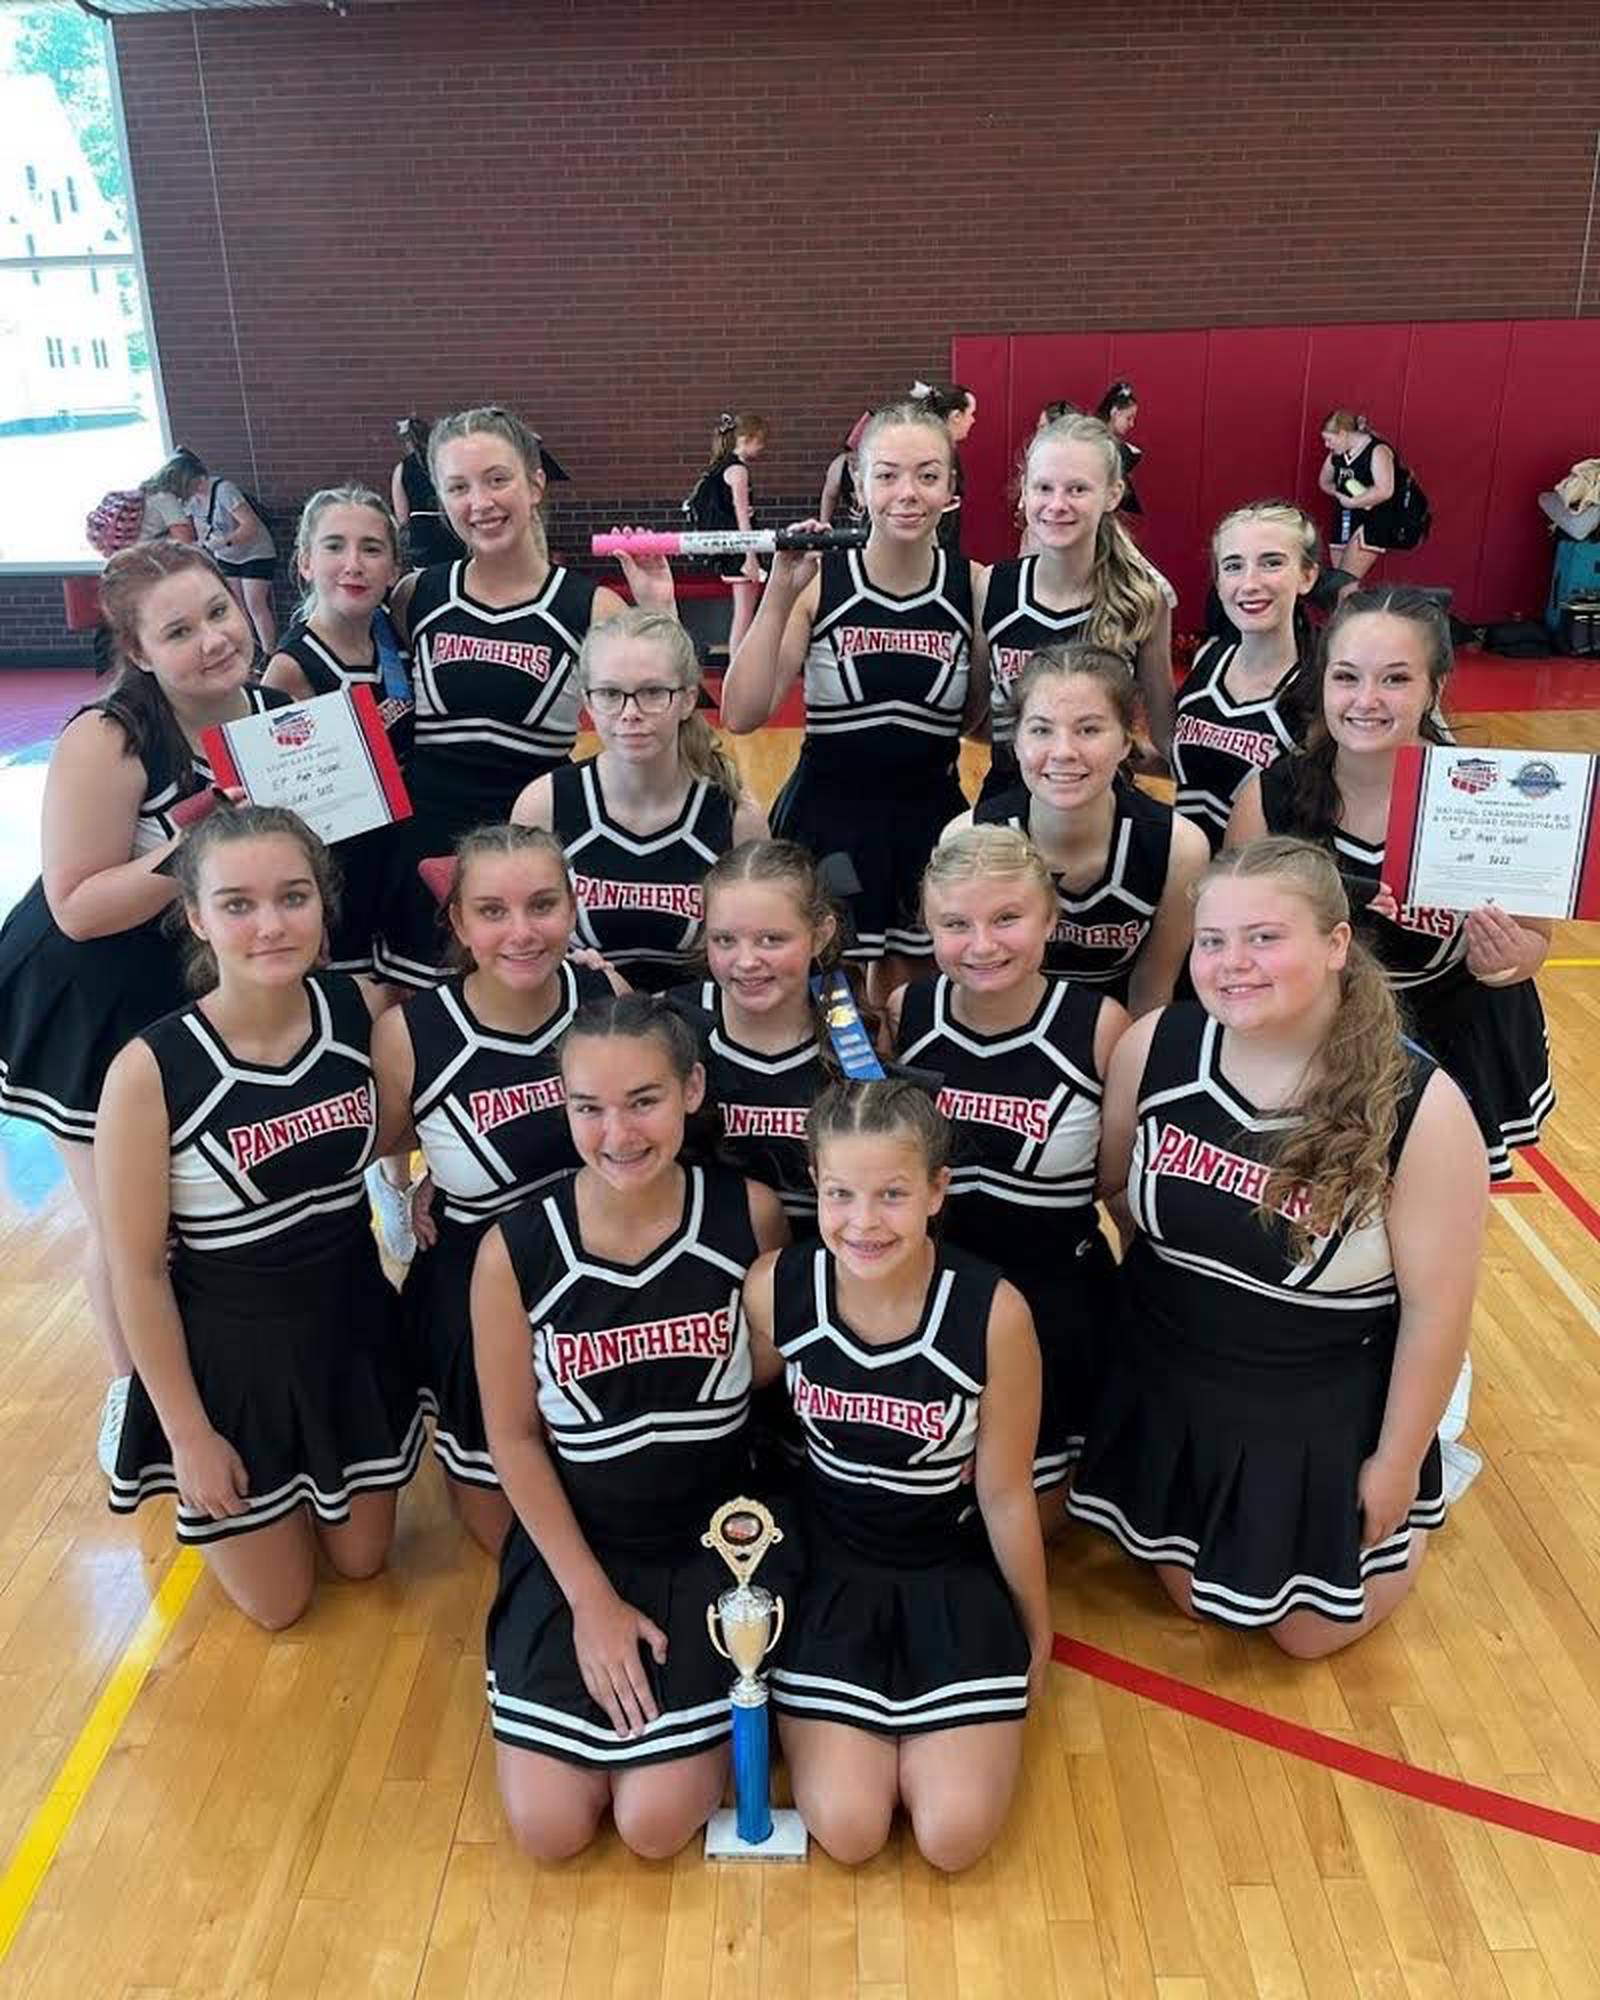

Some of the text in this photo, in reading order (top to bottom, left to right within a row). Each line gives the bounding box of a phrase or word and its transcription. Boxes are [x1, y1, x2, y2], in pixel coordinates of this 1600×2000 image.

[431, 632, 551, 682] PANTHERS
[838, 625, 956, 665] PANTHERS
[575, 874, 704, 921] PANTHERS
[226, 1086, 373, 1177] PANTHERS
[469, 1075, 566, 1136] PANTH
[718, 1102, 812, 1140] NTHE
[935, 1086, 1048, 1144] NTHERS
[1145, 1123, 1334, 1241] PANTHR
[554, 1307, 732, 1386] PANTHERS
[794, 1375, 945, 1441] PANTHERS
